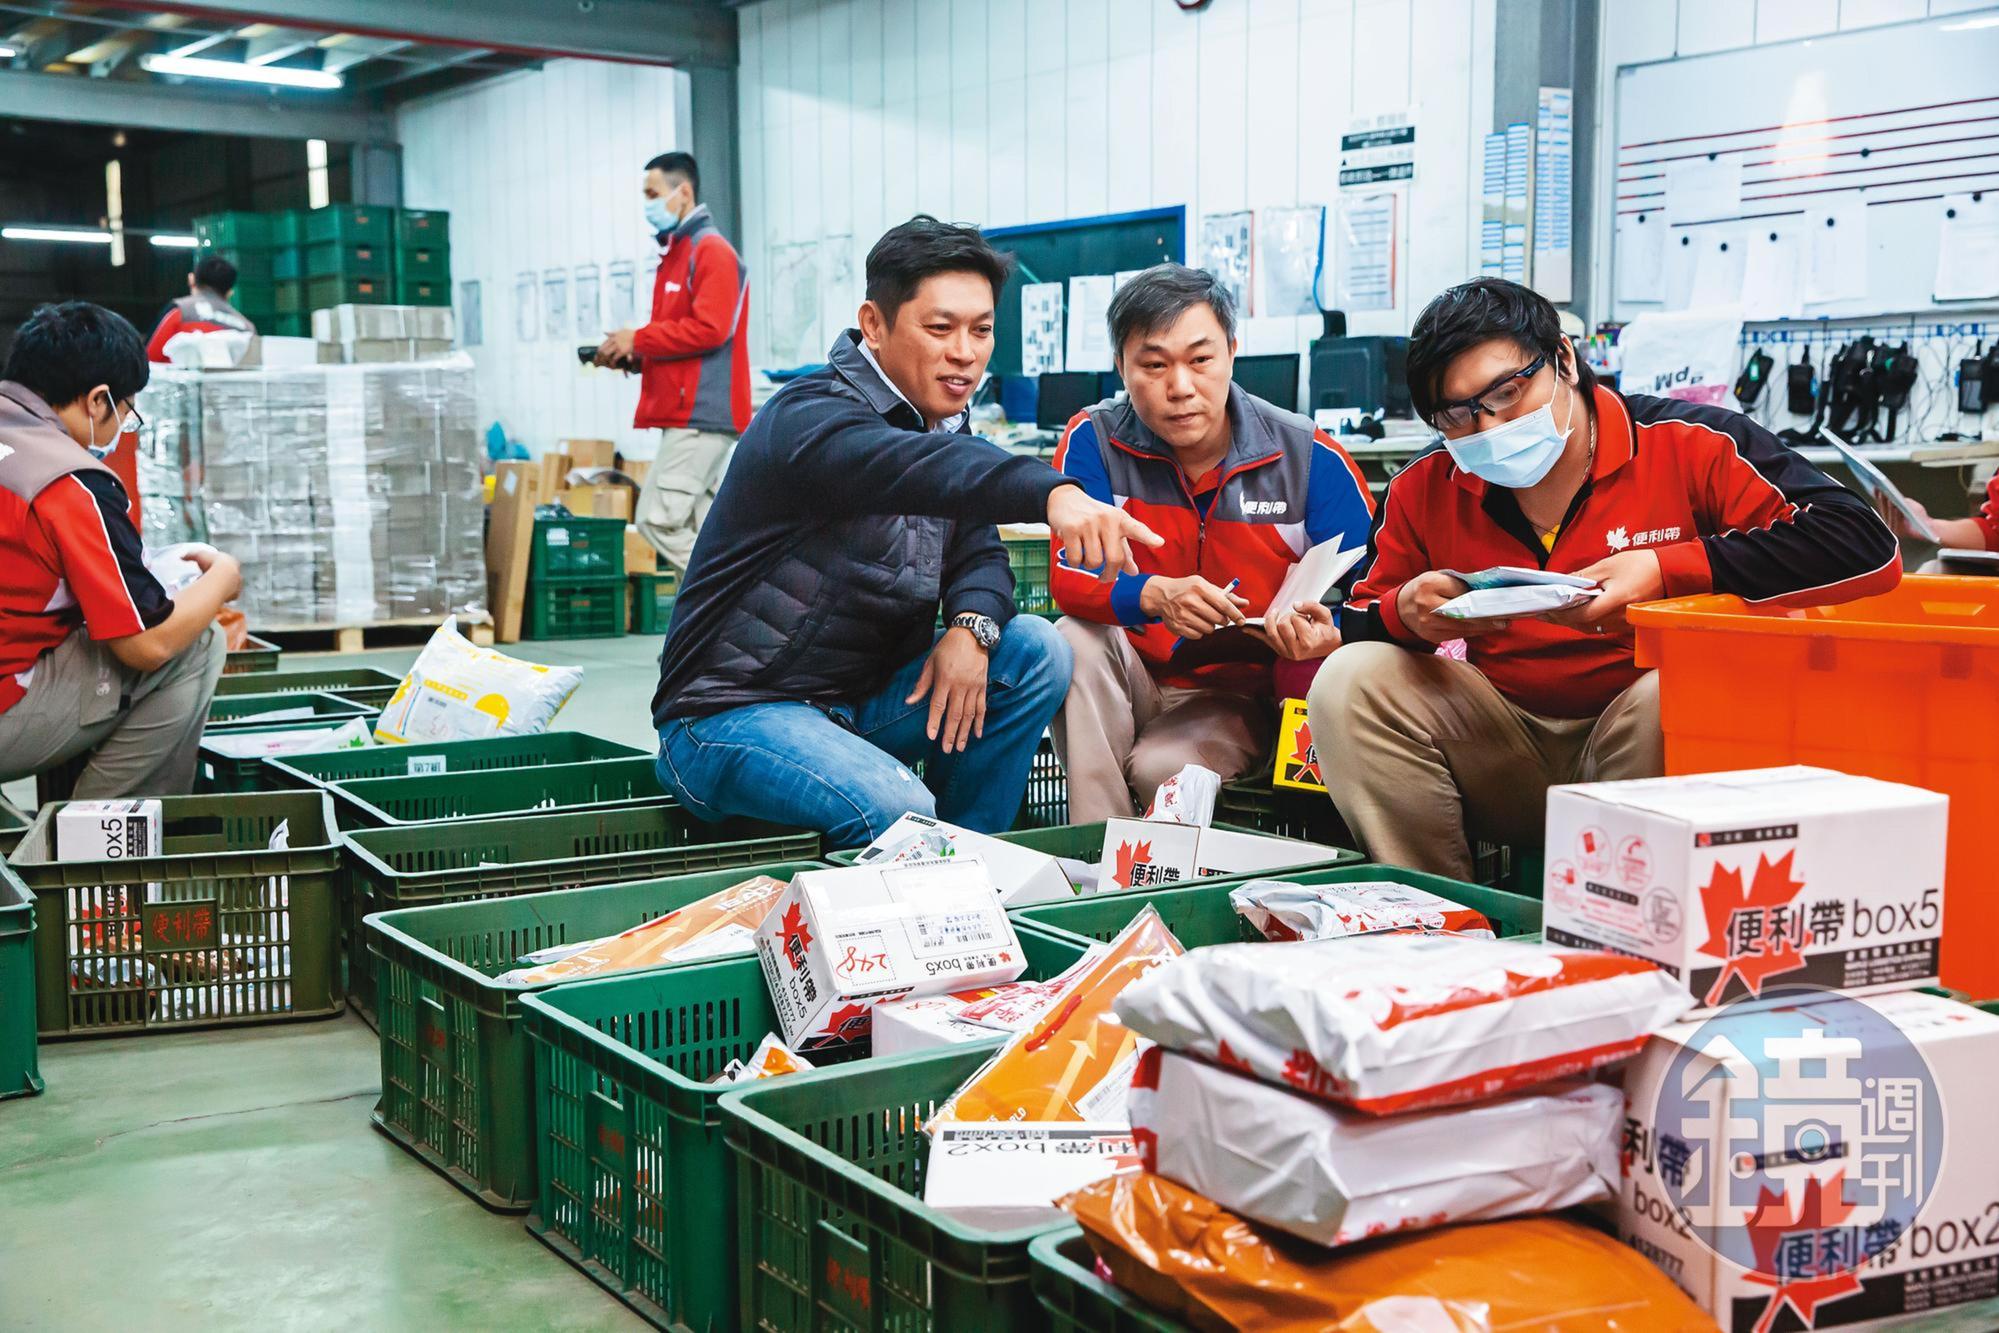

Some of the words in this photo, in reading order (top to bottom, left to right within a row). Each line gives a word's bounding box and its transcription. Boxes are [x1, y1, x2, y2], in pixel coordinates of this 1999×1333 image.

[1632, 526, 1681, 546] 便利帶
[101, 818, 123, 859] ox5
[1131, 863, 1181, 887] 便利帶
[152, 907, 212, 945] 便利帶
[1725, 900, 1845, 958] 便利帶
[1852, 888, 1939, 938] box5
[788, 934, 818, 1002] 便利帶
[925, 958, 962, 976] box5
[966, 957, 997, 971] 便利帶
[789, 976, 808, 1019] box5
[947, 1142, 1046, 1156] box2
[1056, 1142, 1133, 1155] 利帶
[1622, 1117, 1691, 1187] 利帶
[1634, 1181, 1693, 1240] box2
[1774, 1218, 1902, 1286] 便利帶
[1910, 1200, 1999, 1259] box2
